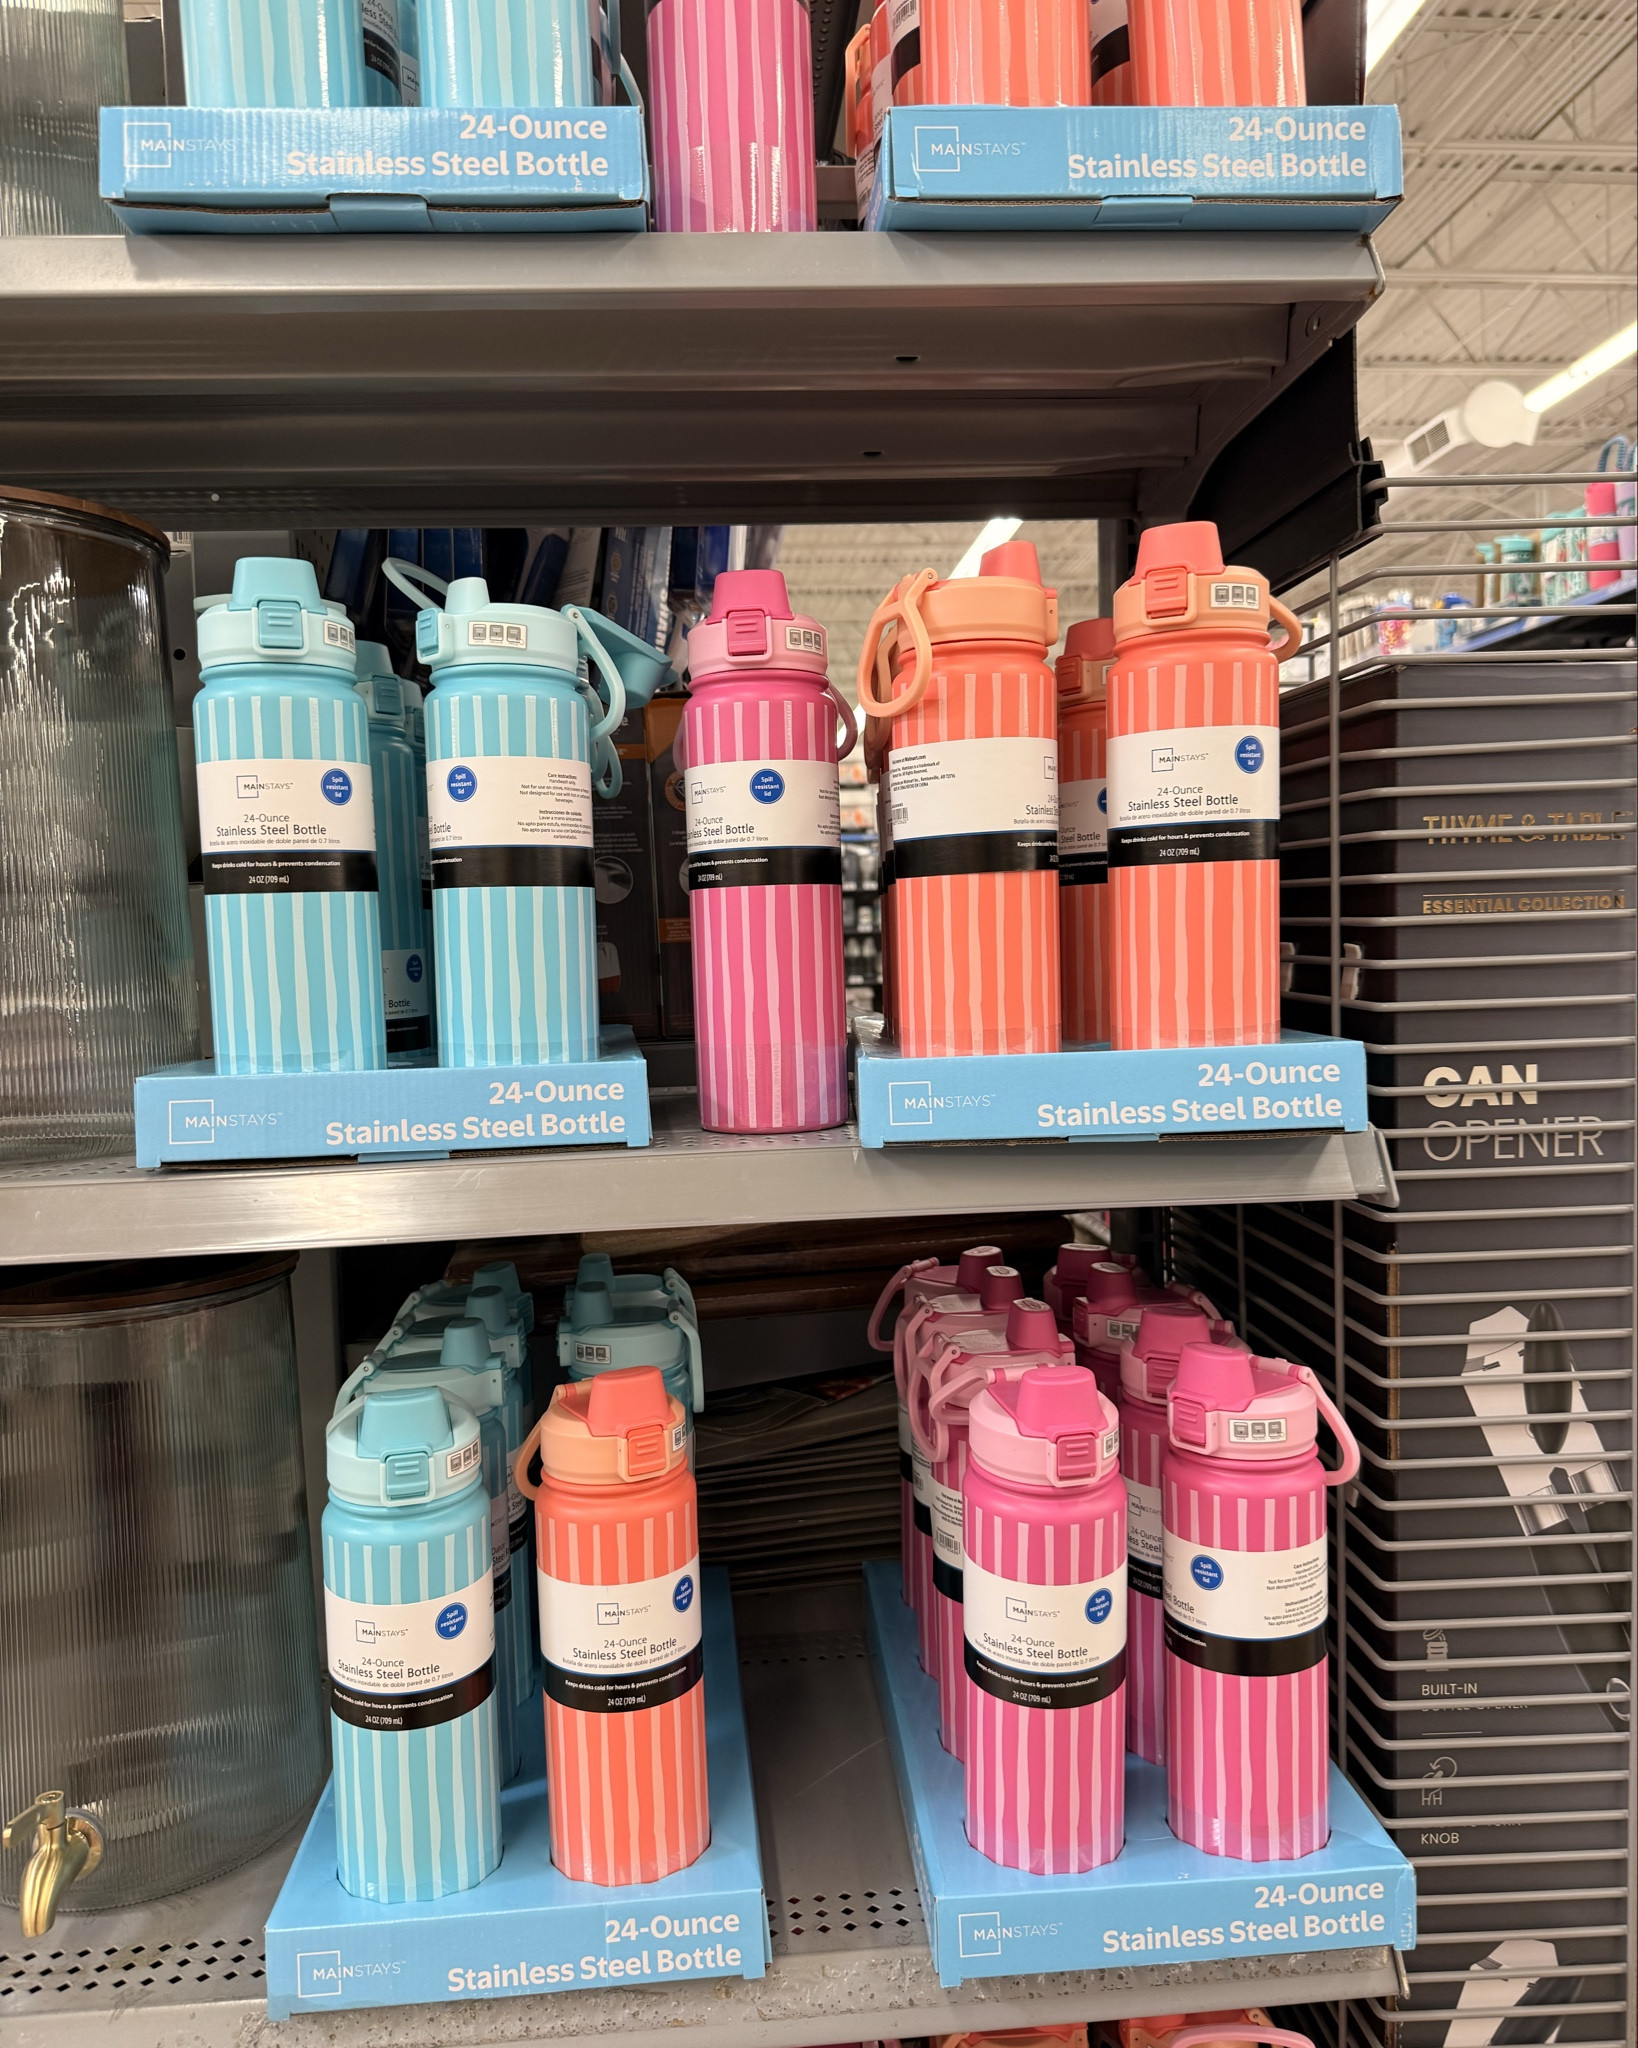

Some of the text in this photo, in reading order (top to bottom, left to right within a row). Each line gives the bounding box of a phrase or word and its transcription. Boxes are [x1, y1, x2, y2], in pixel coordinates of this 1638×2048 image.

[460, 114, 607, 140] 24-Ounce
[1229, 116, 1366, 141] 24-Ounce
[141, 138, 235, 152] MAINSTAYS
[931, 143, 1021, 156] MAINSTAYS
[288, 150, 608, 177] Stainless Steel Bottle
[1069, 153, 1366, 179] Stainless Steel Bottle
[1159, 754, 1206, 763] MAINSTAYS
[332, 776, 343, 784] Spill
[455, 773, 466, 781] Spill
[695, 787, 724, 797] MAINSTAYS
[1157, 786, 1203, 796] 24-Ounce
[1128, 794, 1238, 812] Stainless Steel Bottle
[244, 814, 289, 823] 24-Ounce
[217, 824, 326, 836] Stainless Steel Bottle
[704, 826, 722, 837] Steel
[726, 824, 755, 835] Bottle
[1077, 832, 1100, 841] Bottle
[1423, 895, 1625, 914] ESSENTIAL COLLECTION
[1198, 1062, 1341, 1088] 24-Ounce
[489, 1080, 625, 1106] 24-Ounce
[1424, 1064, 1538, 1108] CAN
[905, 1094, 991, 1109] MAINSTAYS
[1038, 1093, 1342, 1129] Stainless Steel Bottle
[185, 1113, 277, 1129] MAINSTAYS
[326, 1111, 625, 1146] Stainless Steel Bottle
[1424, 1116, 1604, 1161] OPENER
[1195, 1568, 1218, 1578] resistant
[1089, 1601, 1110, 1612] resistant
[1095, 1596, 1105, 1604] Spill
[447, 1610, 458, 1619] Spill
[605, 1606, 649, 1617] MAINSTAYS
[1013, 1606, 1058, 1618] MAINSTAYS
[441, 1616, 464, 1628] resistant
[362, 1629, 406, 1637] MAINSTAYS
[604, 1637, 647, 1649] 24-Ounce
[984, 1633, 1088, 1659] Stainless Steel Bottle
[1011, 1634, 1055, 1648] 24-Ounce
[573, 1638, 677, 1660] Stainless Steel Bottle
[338, 1659, 373, 1679] Stainless
[377, 1668, 403, 1679] Steel
[408, 1664, 440, 1678] Bottle
[362, 1657, 404, 1668] 24-Ounce
[1421, 1682, 1478, 1695] BUILT-IN
[1421, 1833, 1459, 1844] KNOB
[1255, 1882, 1384, 1910] 24-Ounce
[606, 1914, 740, 1943] 24-Ounce
[974, 1924, 1058, 1941] MAINSTAYS
[1103, 1911, 1385, 1954] Stainless Steel Bottle
[313, 1962, 401, 1981] MAINSTAYS
[448, 1944, 742, 1992] Stainless Steel Bottle
